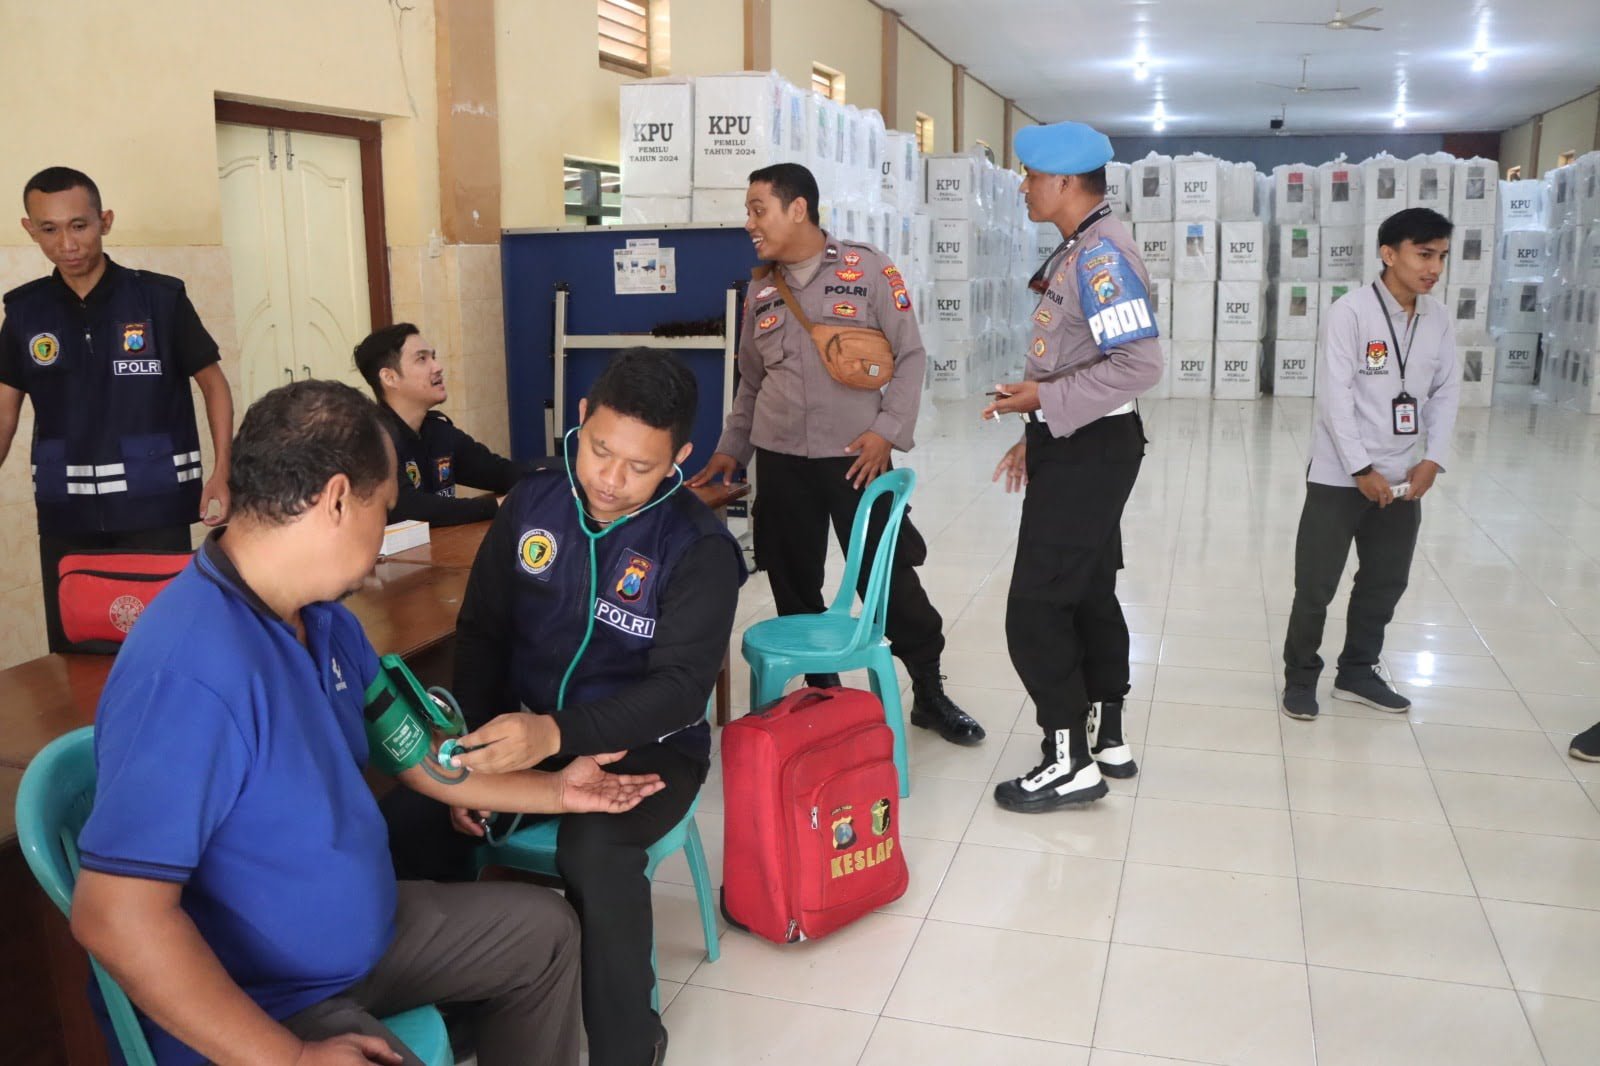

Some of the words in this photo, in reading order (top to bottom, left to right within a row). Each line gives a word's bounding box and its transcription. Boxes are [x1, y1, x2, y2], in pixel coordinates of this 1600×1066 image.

[708, 115, 752, 135] KPU
[632, 122, 674, 142] KPU
[936, 179, 960, 191] KPU
[1184, 181, 1208, 193] KPU
[1510, 199, 1531, 209] KPU
[936, 241, 960, 253] KPU
[1144, 240, 1168, 252] KPU
[1230, 242, 1255, 253] KPU
[1330, 246, 1353, 257] KPU
[1517, 248, 1539, 259] KPU
[824, 285, 868, 297] POLRI
[1045, 289, 1064, 305] POLRI
[937, 299, 961, 311] KPU
[1226, 302, 1250, 314] KPU
[1088, 298, 1152, 346] PROV
[1508, 350, 1530, 360] KPU
[1180, 360, 1205, 372] KPU
[1224, 360, 1249, 372] KPU
[1282, 359, 1306, 370] KPU
[597, 602, 651, 635] POLRI
[830, 836, 894, 880] KESLAP
